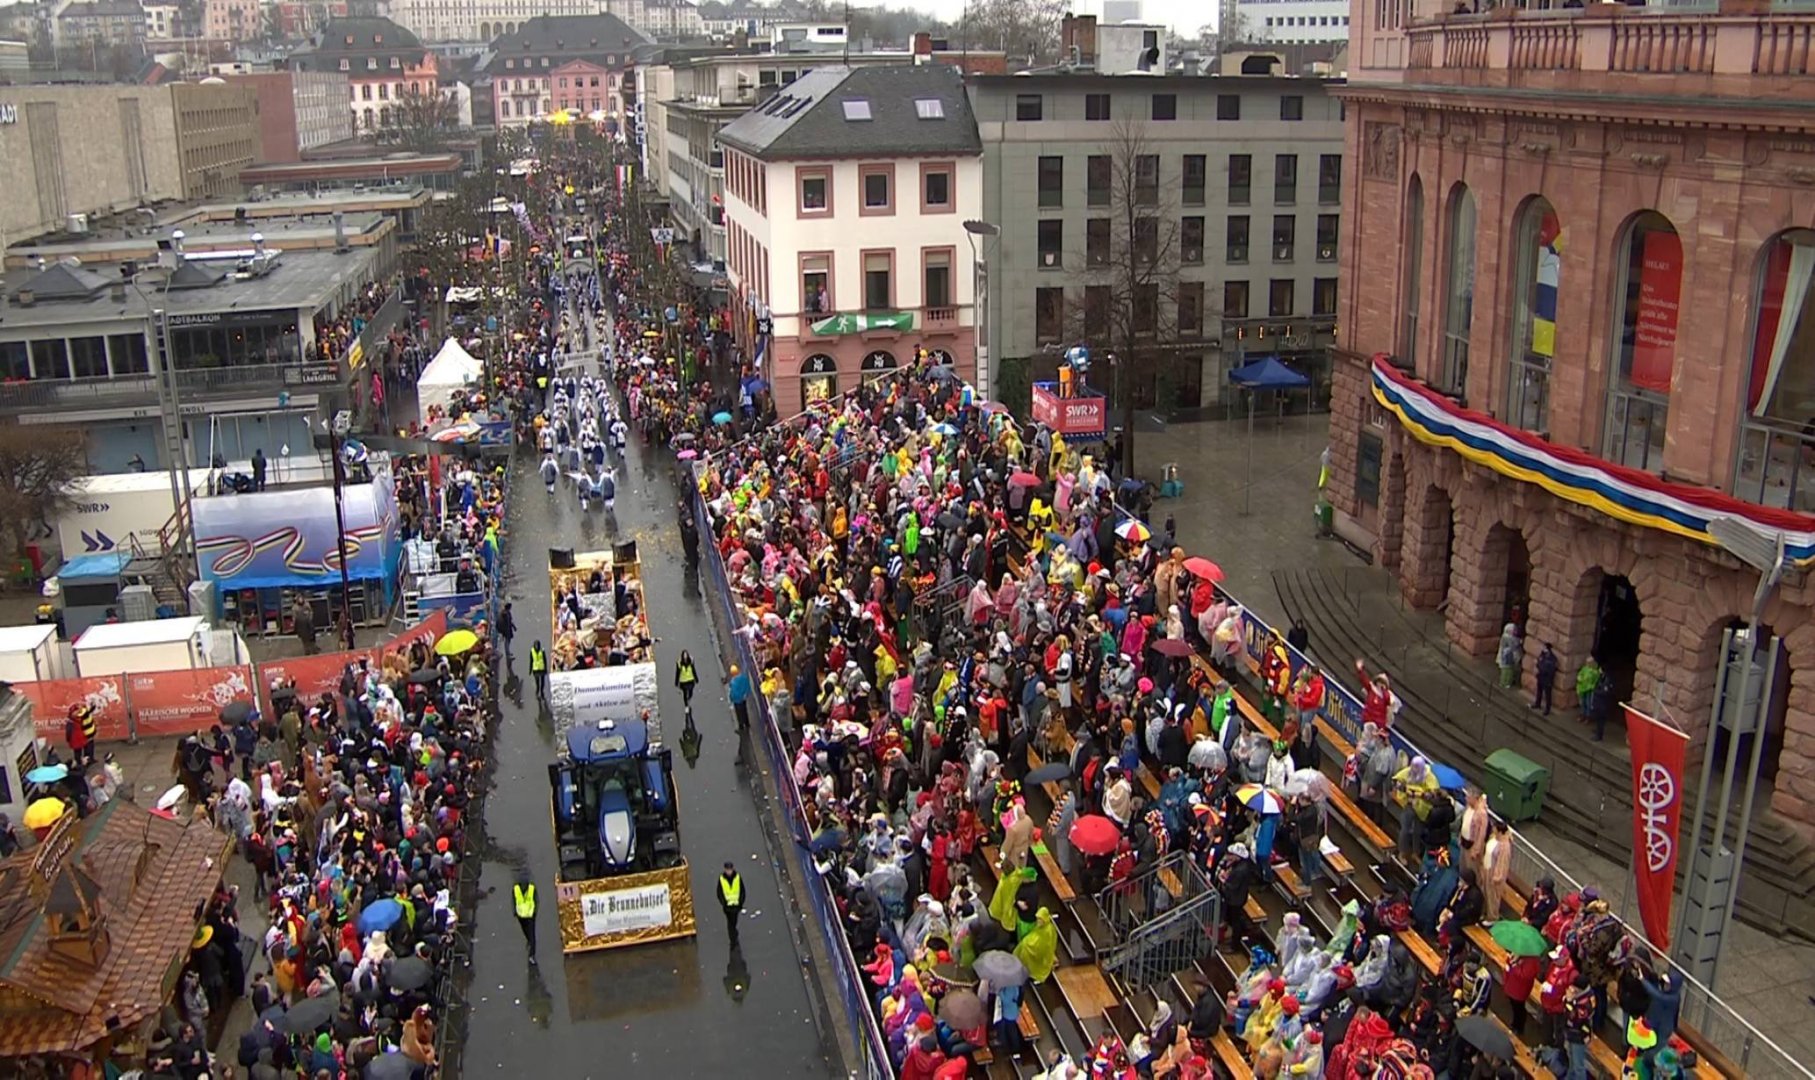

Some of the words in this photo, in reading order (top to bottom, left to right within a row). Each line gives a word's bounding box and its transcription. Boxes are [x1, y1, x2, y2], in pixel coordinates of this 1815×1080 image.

[0, 104, 18, 123] ADT
[169, 313, 221, 325] ADTBALKON
[1065, 404, 1088, 417] SWR
[77, 503, 100, 514] SWR
[180, 704, 213, 715] WOCHEN
[563, 887, 574, 896] 11
